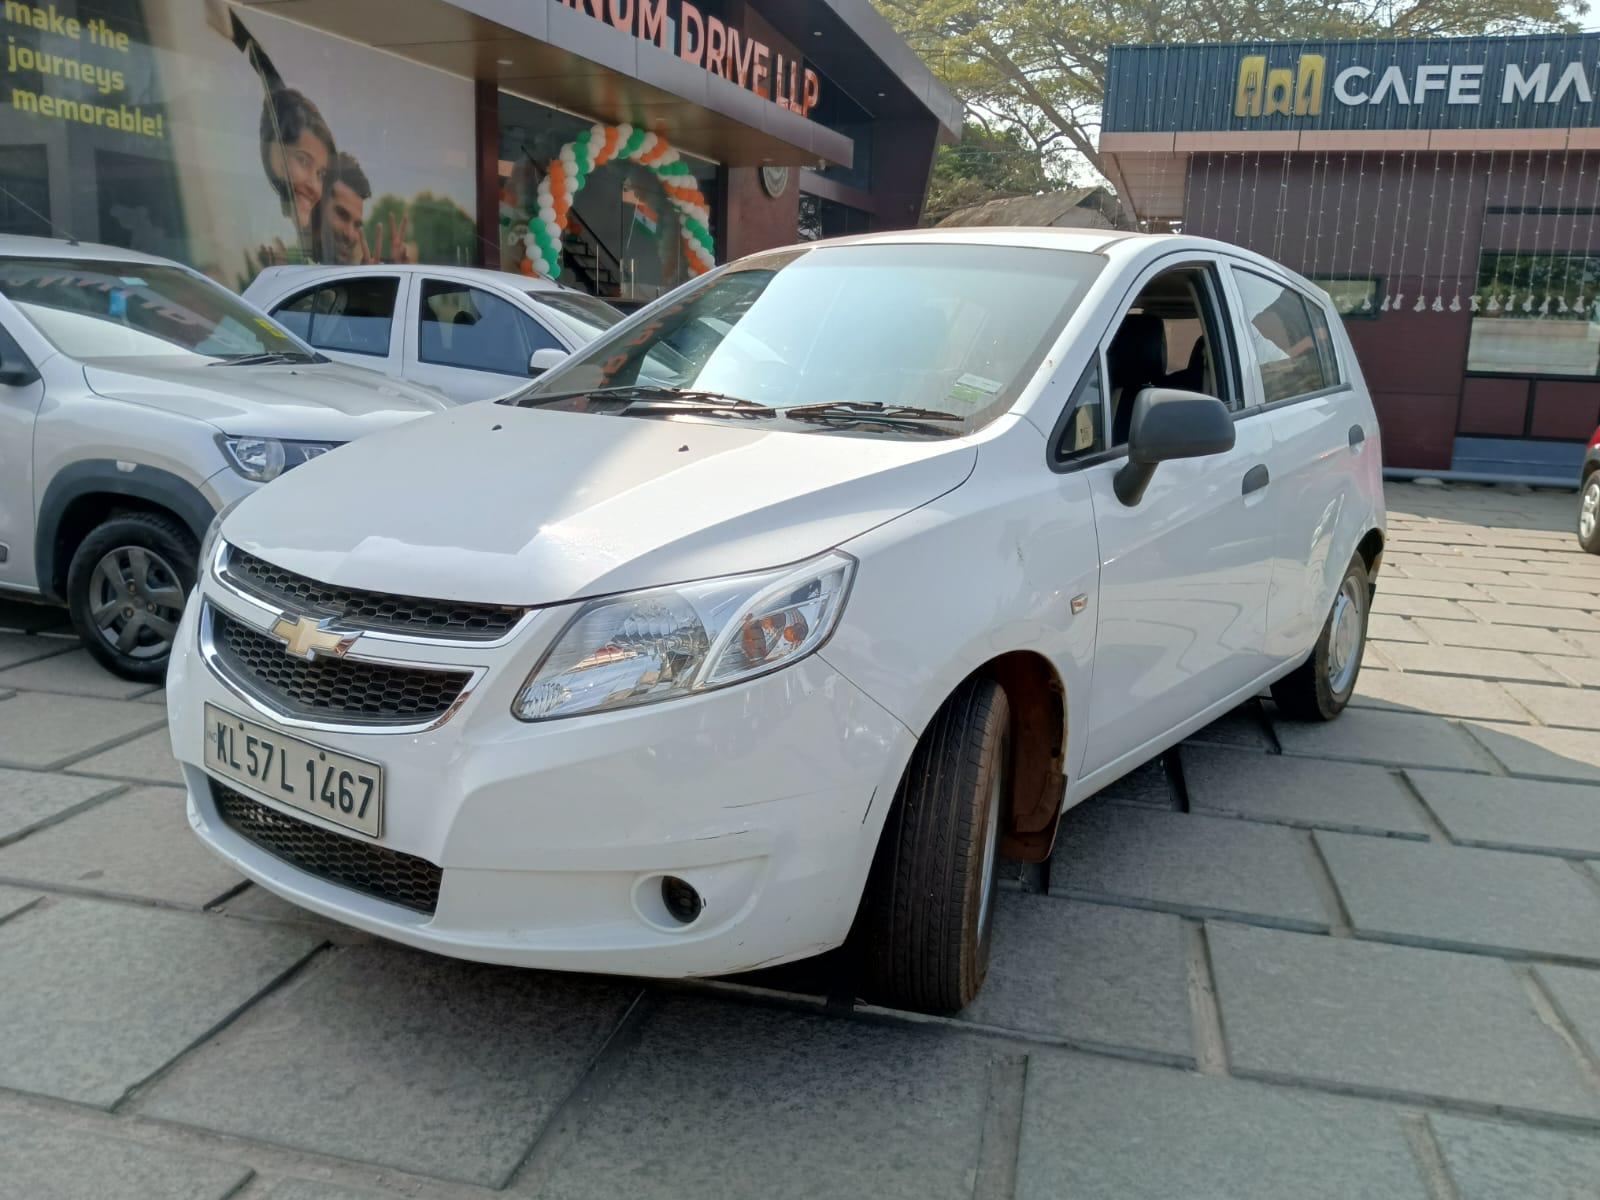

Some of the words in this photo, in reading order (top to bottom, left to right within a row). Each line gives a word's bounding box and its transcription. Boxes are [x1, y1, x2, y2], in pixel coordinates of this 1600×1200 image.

[5, 0, 81, 38] make
[88, 19, 129, 51] the
[8, 37, 125, 93] journeys
[681, 0, 768, 98] DRIVE
[776, 52, 819, 117] LLP
[1334, 66, 1484, 105] CAFE
[1501, 62, 1592, 103] MA
[12, 89, 163, 137] memorable!
[217, 721, 240, 769] KL
[306, 758, 374, 819] 1467
